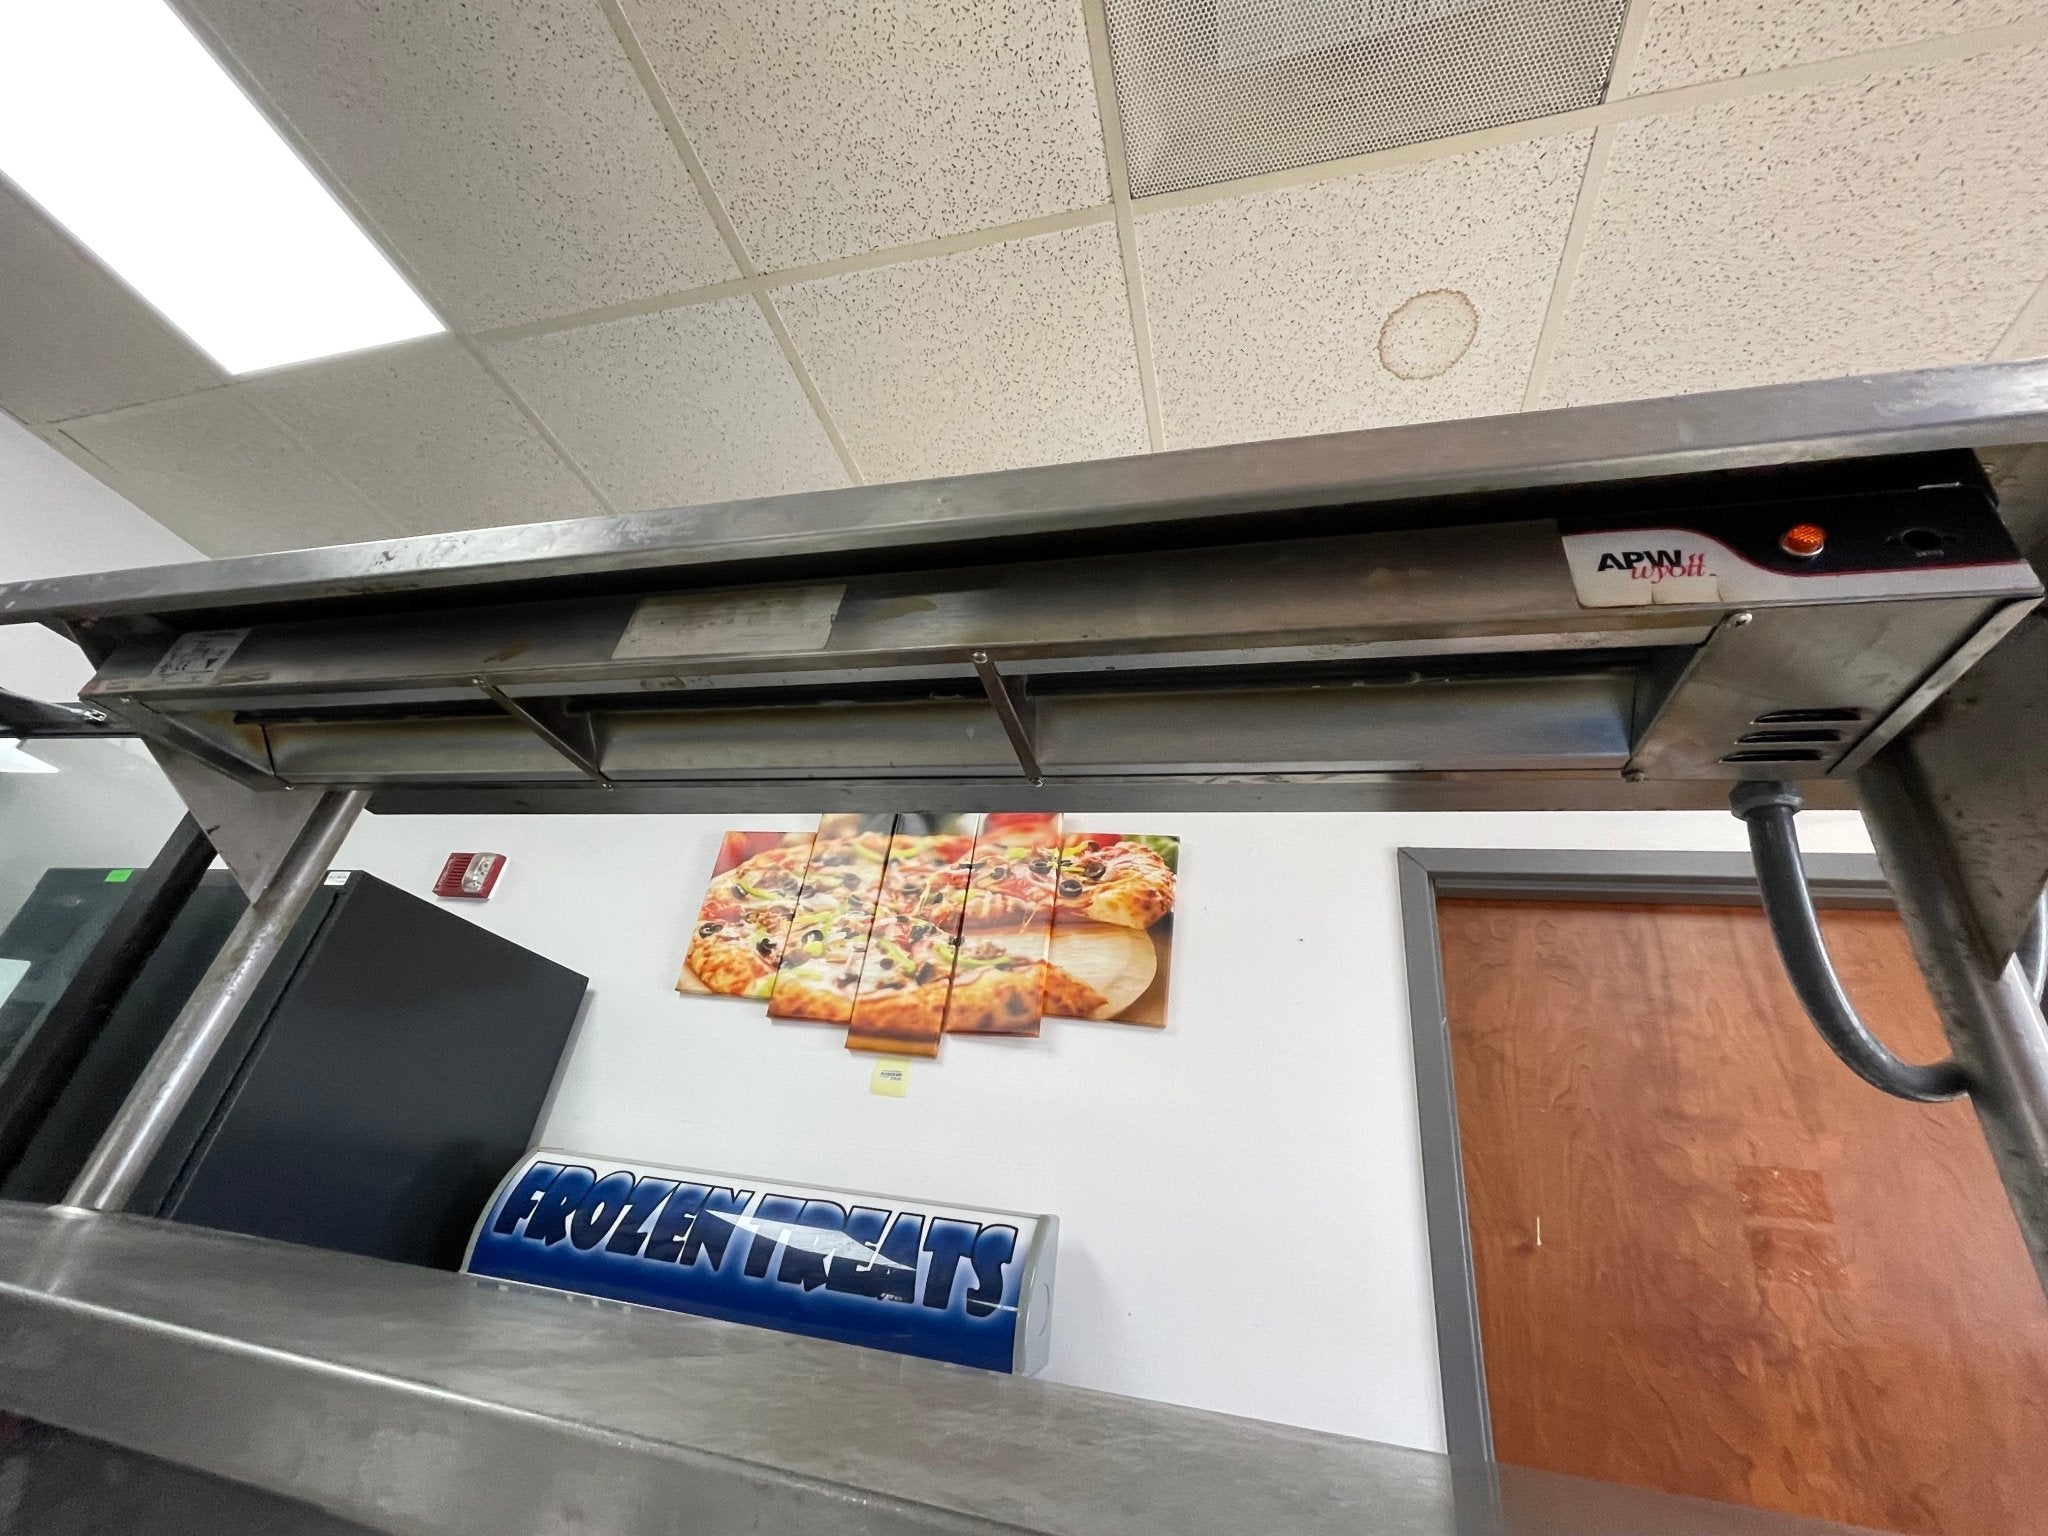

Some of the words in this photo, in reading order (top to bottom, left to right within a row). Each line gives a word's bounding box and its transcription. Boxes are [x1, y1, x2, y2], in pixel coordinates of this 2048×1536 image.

[1598, 549, 1681, 571] APW
[493, 1160, 755, 1271] FROZEN
[743, 1192, 1019, 1318] TREATS
